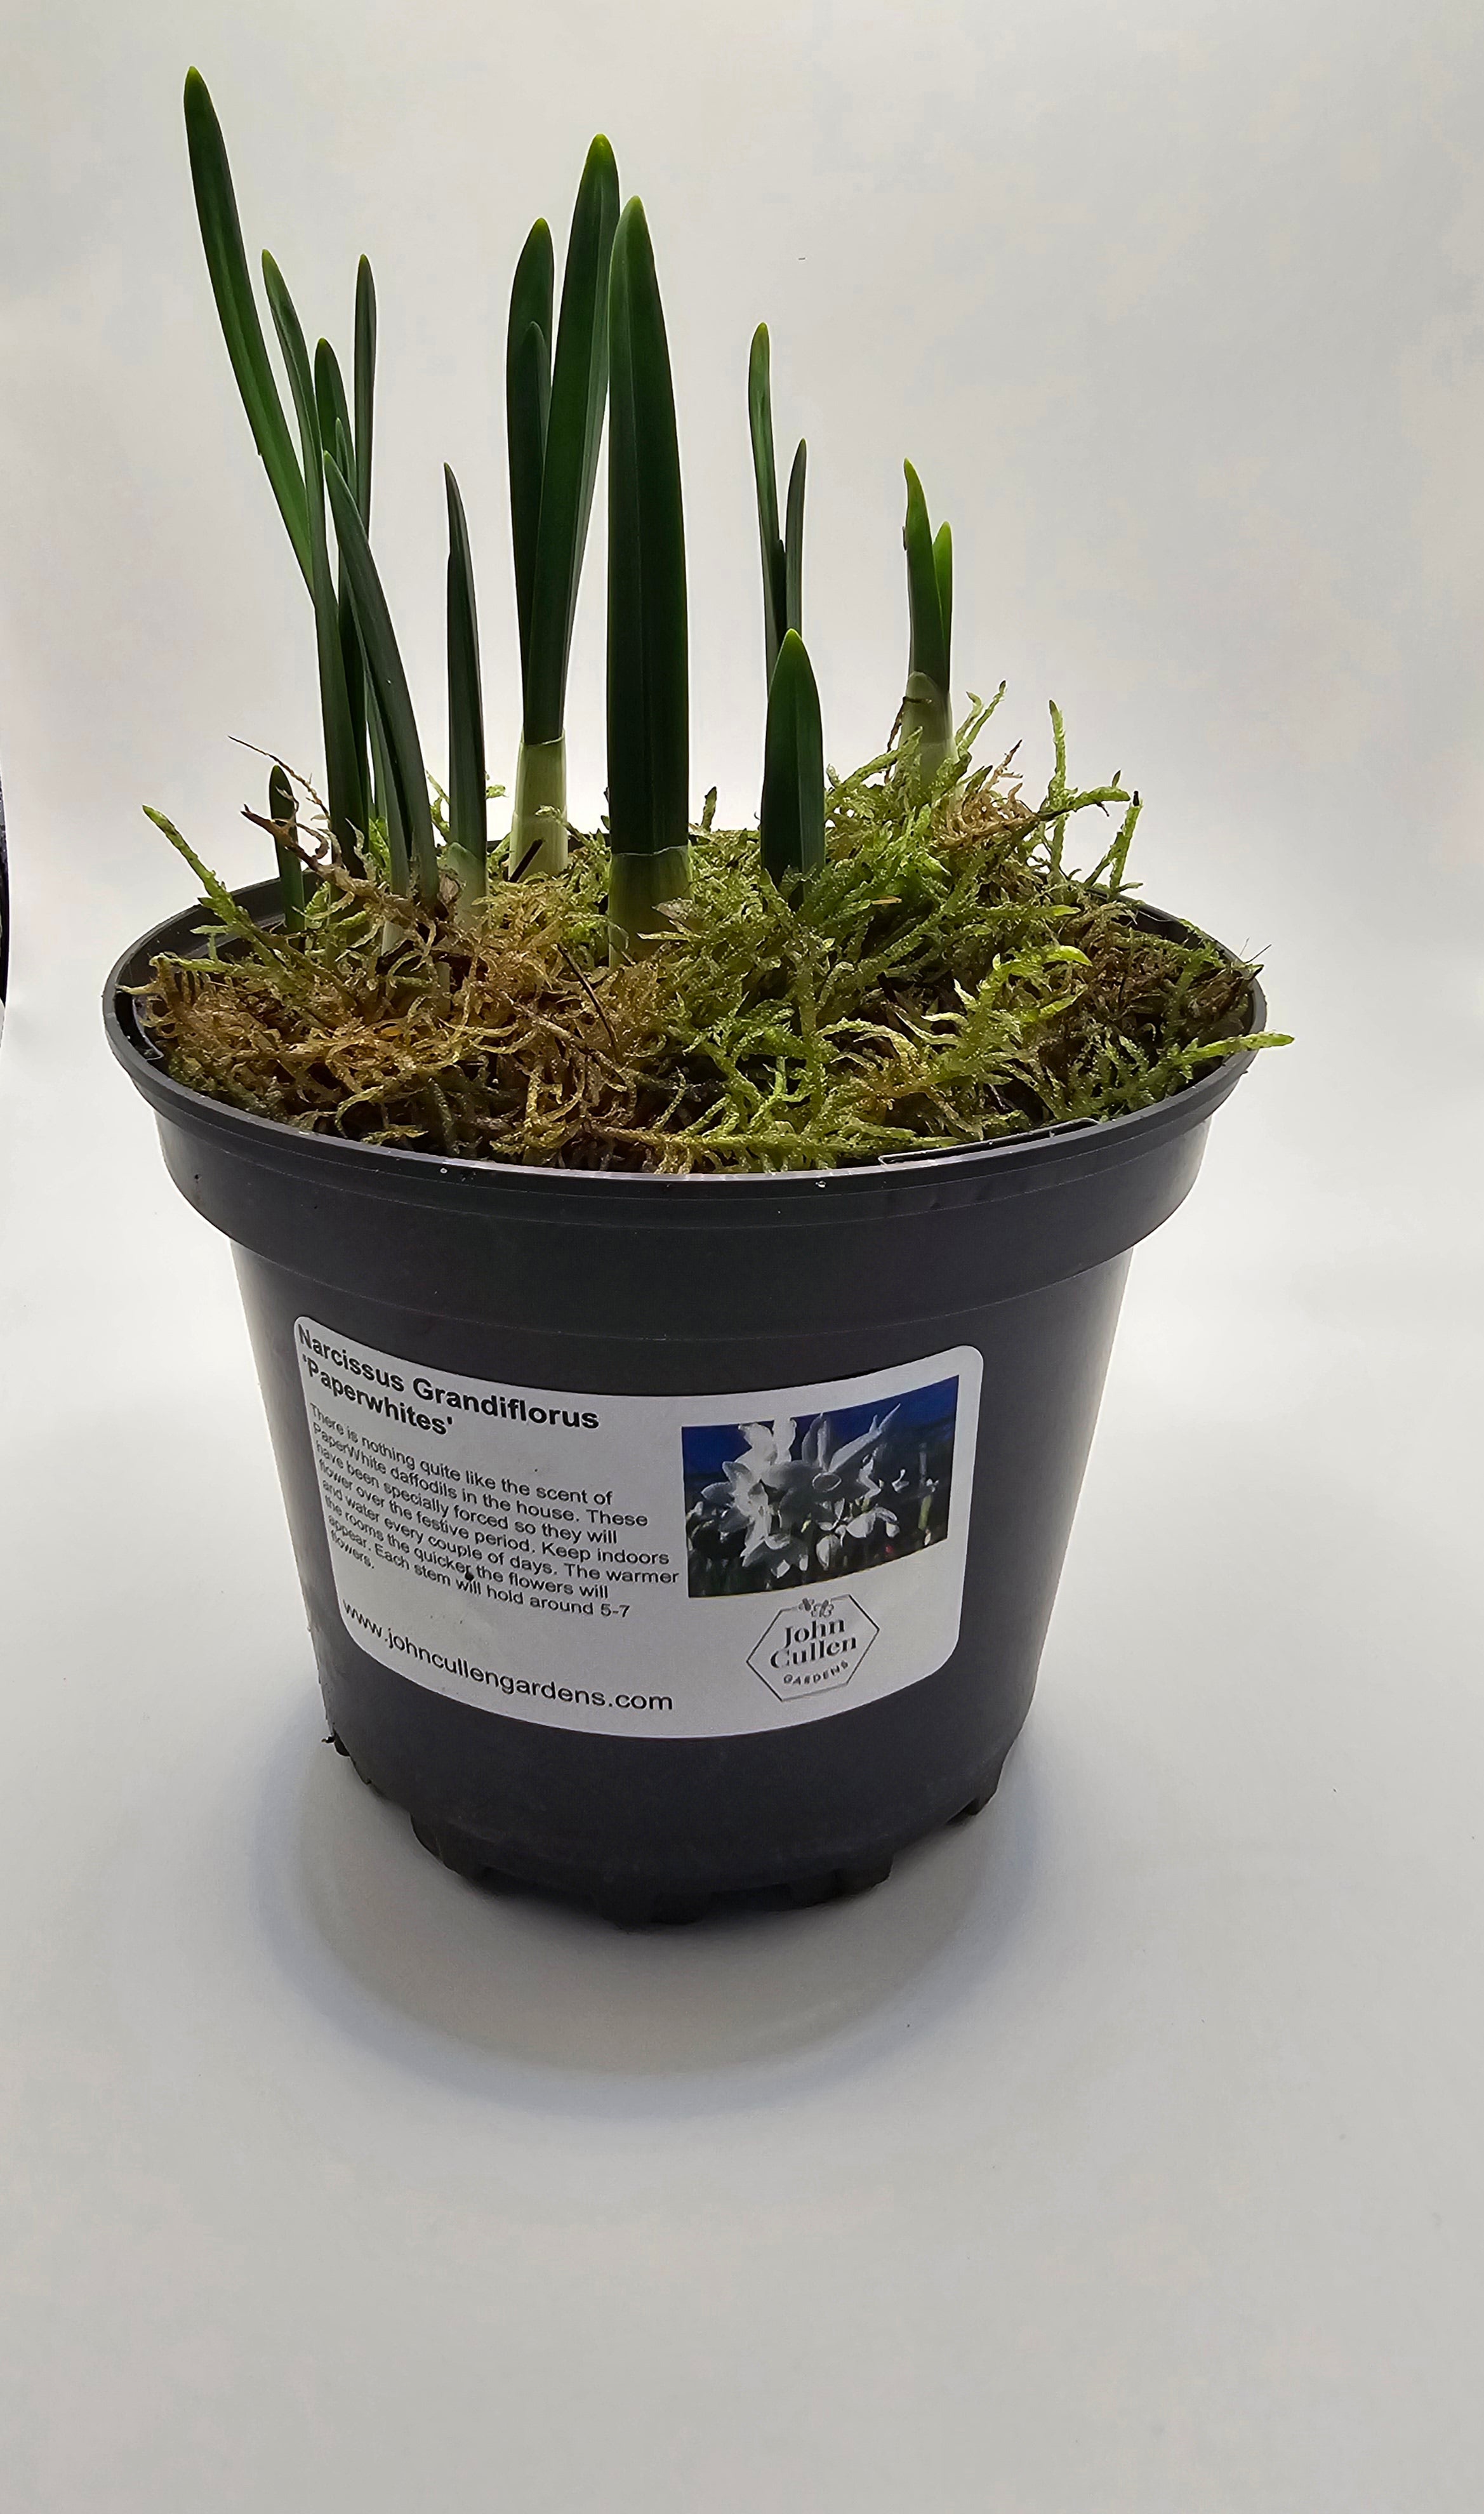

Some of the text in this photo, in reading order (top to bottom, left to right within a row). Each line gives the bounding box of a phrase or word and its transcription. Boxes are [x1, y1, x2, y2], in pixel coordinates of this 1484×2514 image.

[298, 1324, 599, 1428] Narcissus Grandiflorus
[302, 1354, 453, 1435] 'Paperwhites'
[310, 1402, 613, 1505] There is nothing quite like the scent of
[313, 1422, 648, 1526] PaperWhite daffodils in the house. These
[345, 1495, 380, 1522] water
[384, 1518, 423, 1544] every
[428, 1536, 482, 1560] couple
[487, 1552, 505, 1565] of
[510, 1556, 557, 1575] days.
[564, 1562, 600, 1580] The
[606, 1570, 679, 1583] warmer
[347, 1460, 380, 1488] been
[383, 1483, 449, 1518] specially
[454, 1505, 508, 1529] forced
[514, 1521, 536, 1534] so
[541, 1524, 581, 1544] they
[586, 1529, 617, 1543] will
[356, 1486, 385, 1507] over
[389, 1500, 412, 1520] the
[416, 1511, 469, 1539] festive
[475, 1531, 535, 1553] period.
[542, 1541, 591, 1562] Keep
[597, 1548, 670, 1564] indoors
[328, 1515, 630, 1618] appear. Each stem will hold around 5-7
[345, 1512, 383, 1541] rooms
[387, 1533, 409, 1553] the
[414, 1548, 471, 1573] quicker
[476, 1565, 503, 1583] the
[508, 1572, 574, 1594] flowers
[580, 1585, 608, 1599] will
[342, 1599, 673, 1710] www.johncullengardens.com
[770, 1637, 856, 1668] Cullen
[783, 1659, 849, 1686] GARDENS
[785, 1619, 845, 1649] John
